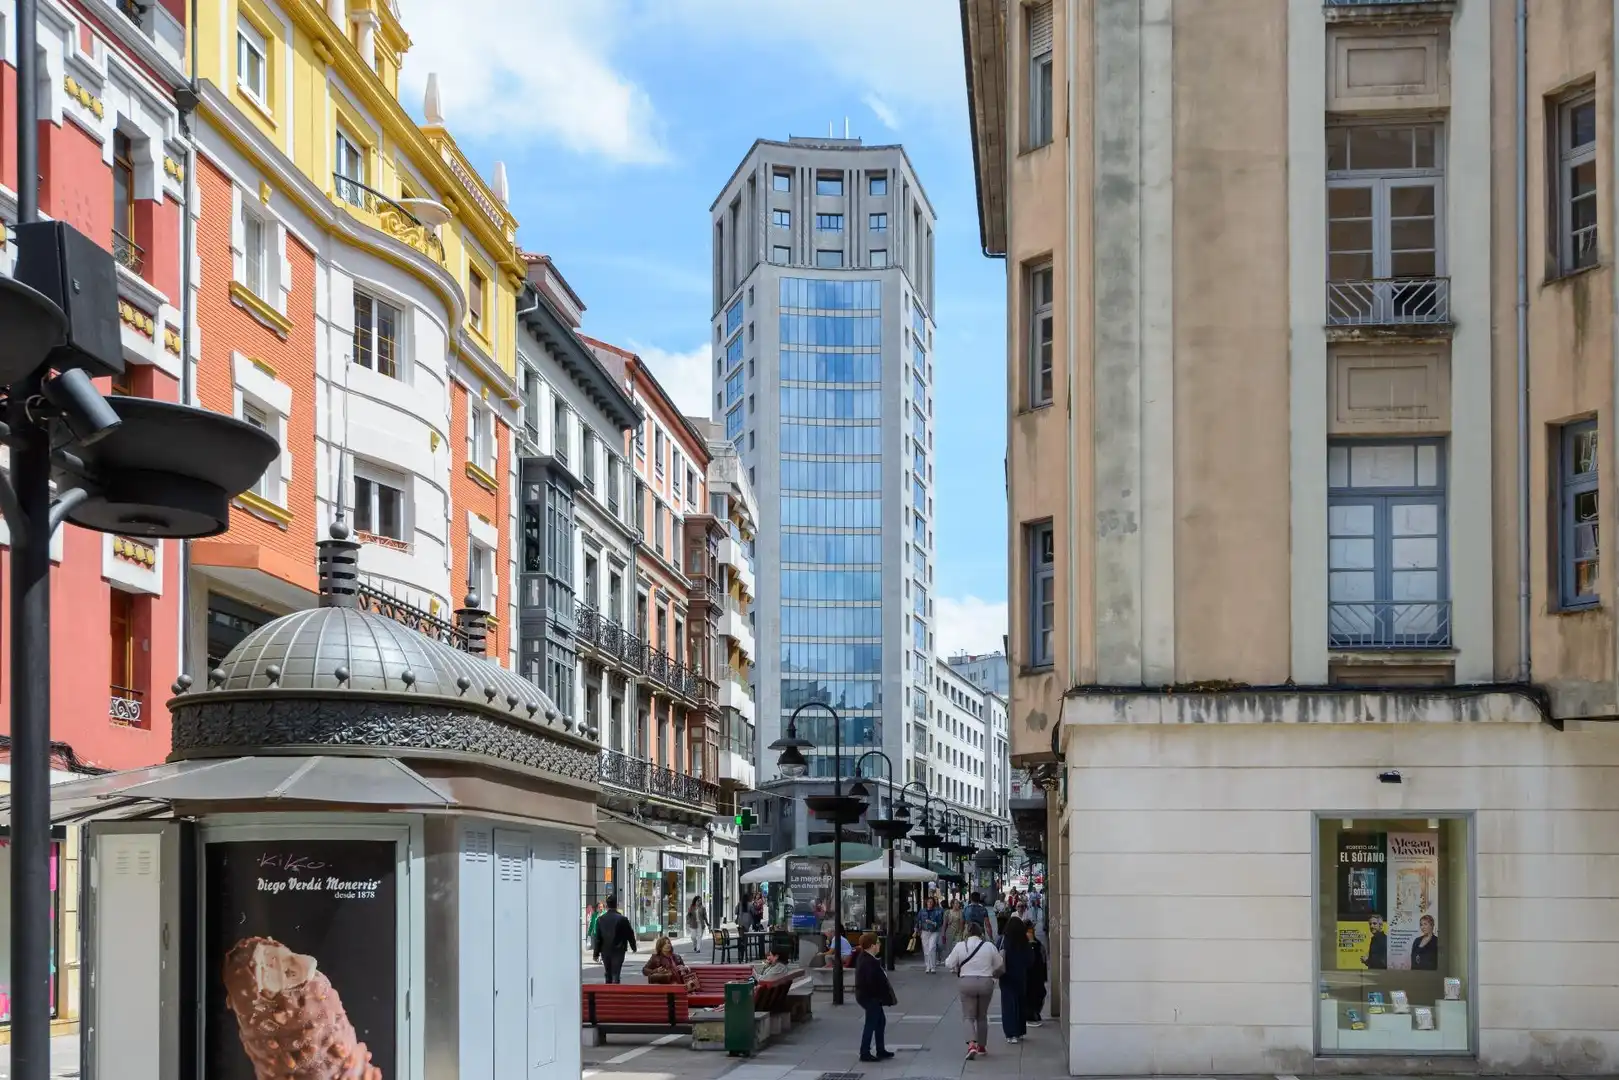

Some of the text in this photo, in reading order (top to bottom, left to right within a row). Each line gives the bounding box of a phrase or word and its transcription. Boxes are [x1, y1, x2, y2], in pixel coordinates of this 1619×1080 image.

[1394, 838, 1430, 848] Megan
[1392, 846, 1435, 855] Maxwell
[1340, 850, 1385, 863] EL SÓTANO
[257, 876, 380, 895] Diego Verdú Monerris
[334, 891, 376, 899] desde 1878
